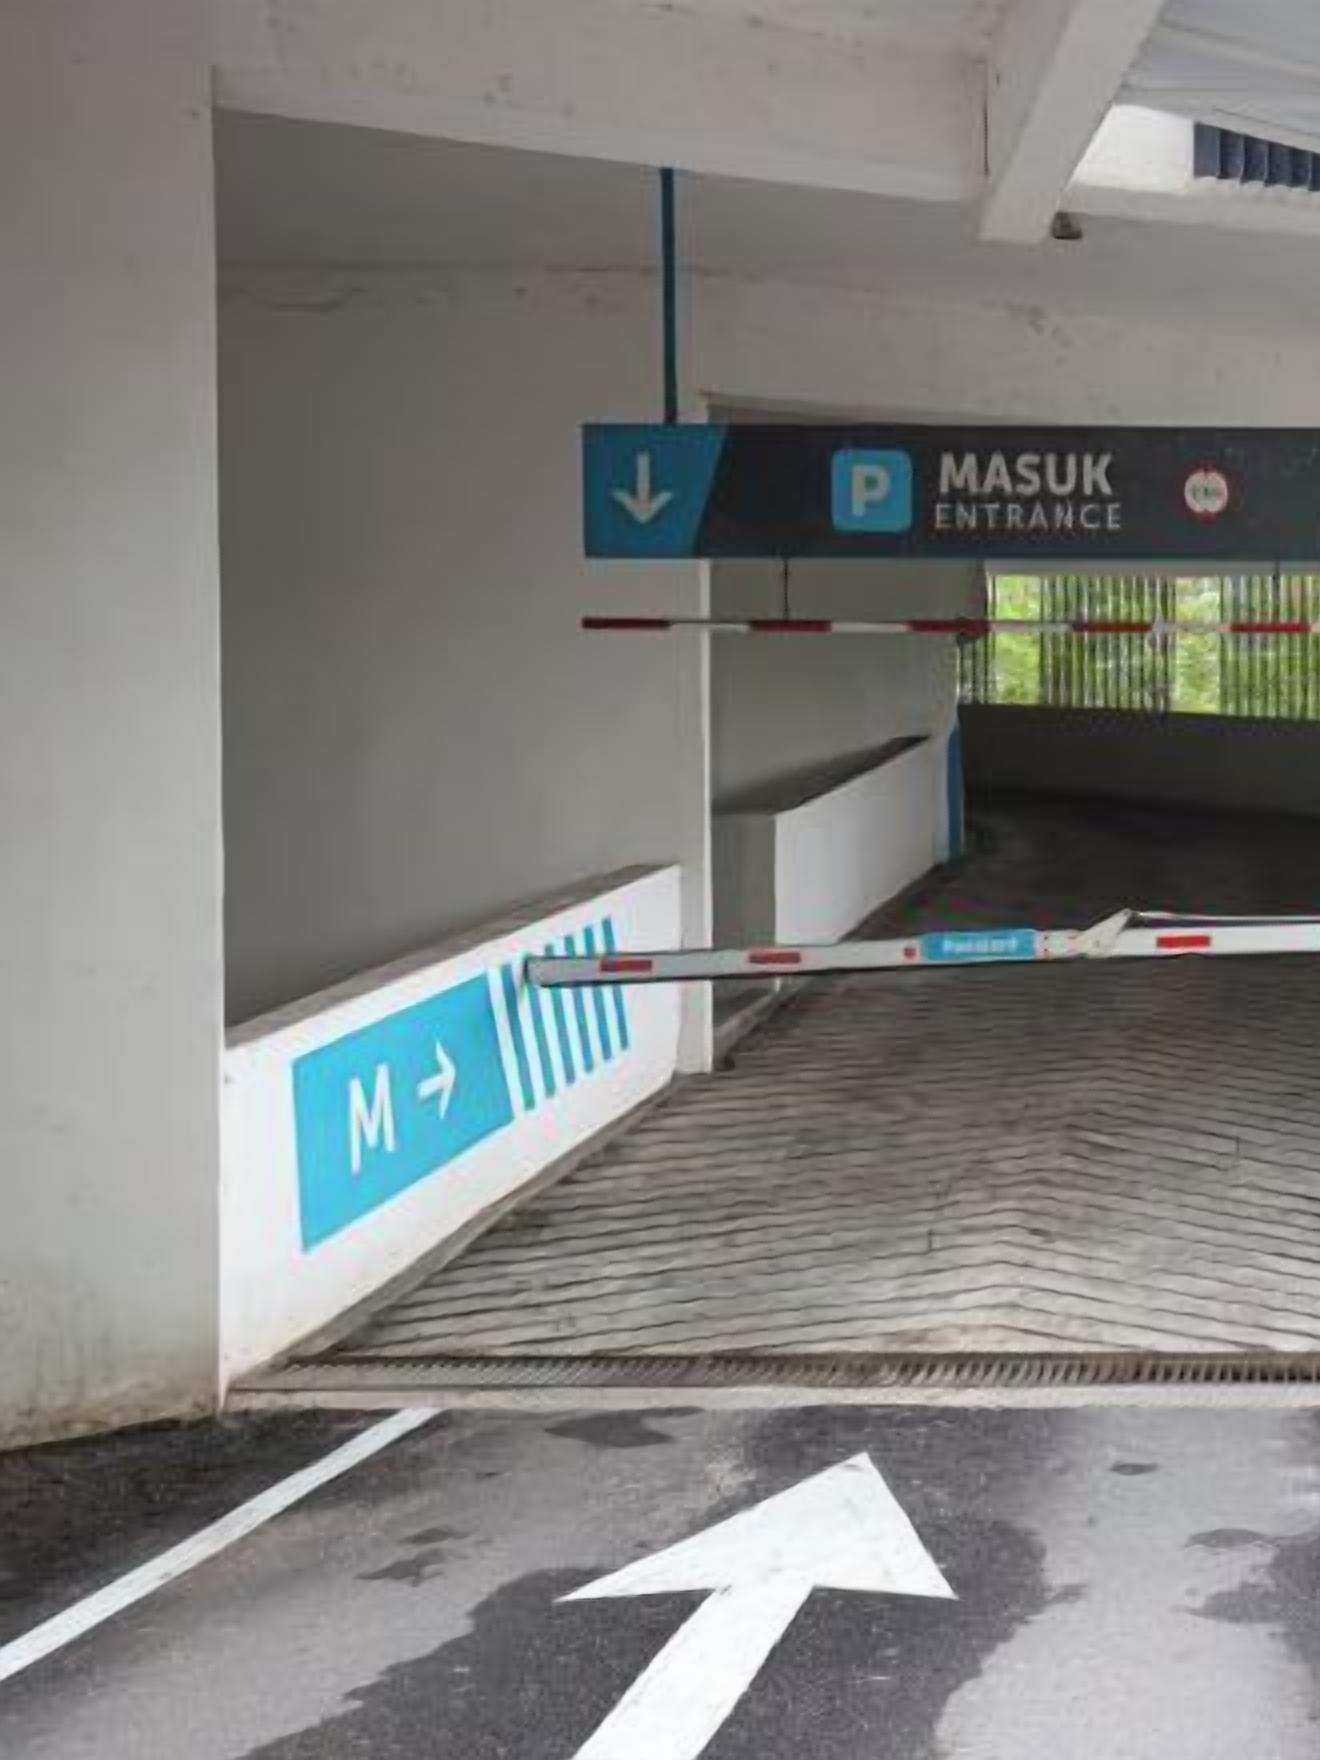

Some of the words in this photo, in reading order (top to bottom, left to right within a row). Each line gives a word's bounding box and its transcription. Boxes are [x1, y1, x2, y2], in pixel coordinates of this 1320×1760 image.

[851, 464, 890, 518] P
[940, 452, 1114, 496] MASUK
[934, 503, 1122, 530] ENTRANCE
[350, 1062, 396, 1174] M
